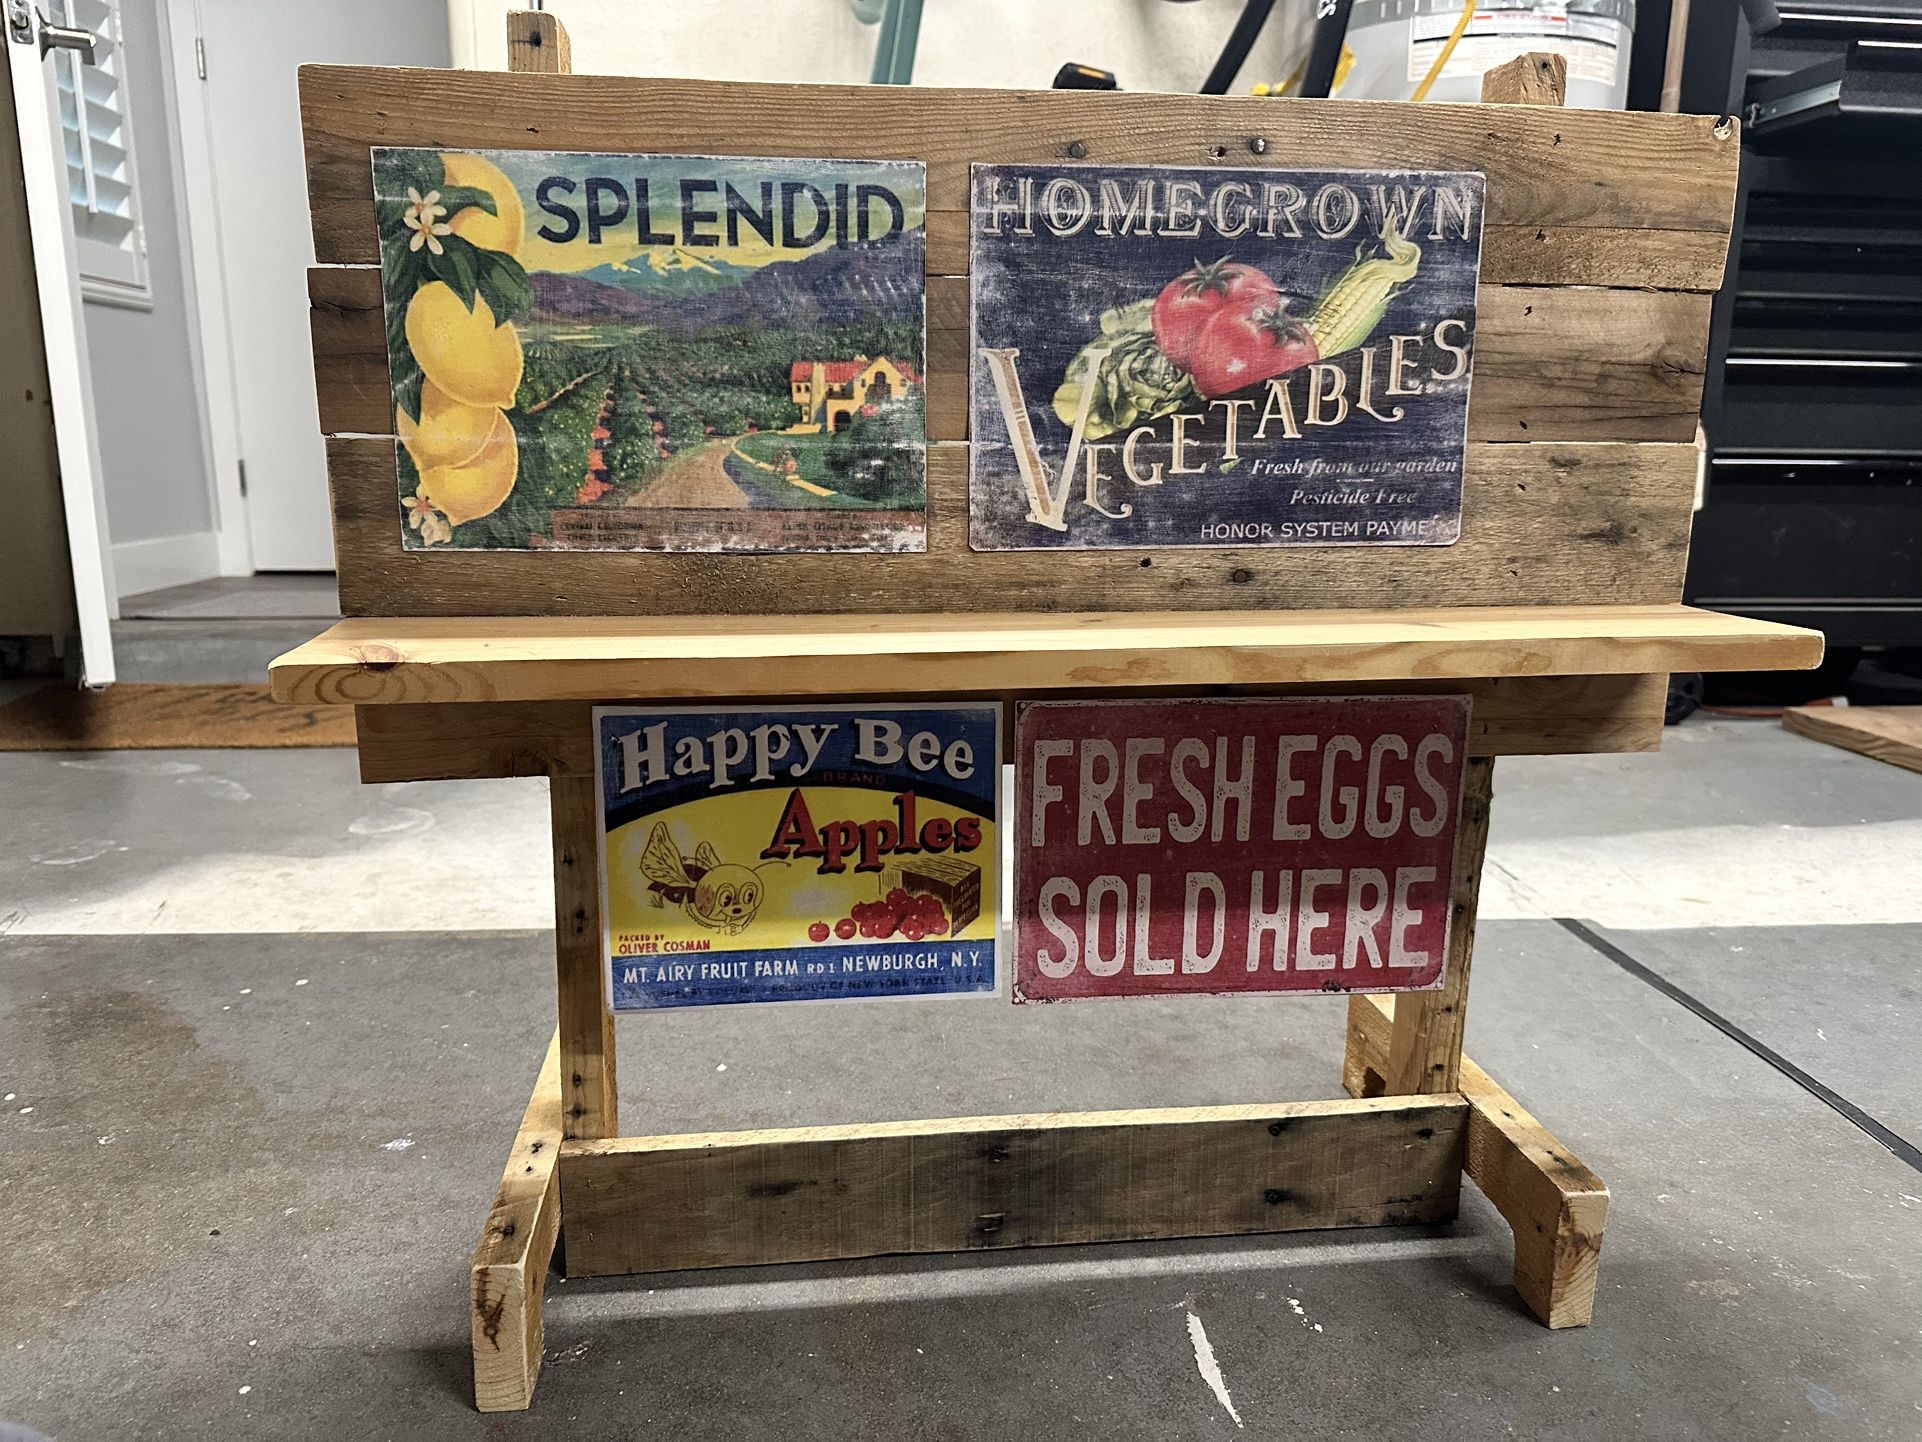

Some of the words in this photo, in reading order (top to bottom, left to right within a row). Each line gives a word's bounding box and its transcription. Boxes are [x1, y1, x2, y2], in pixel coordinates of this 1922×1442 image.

[535, 175, 905, 249] SPLENDID
[983, 176, 1473, 242] HOMEGROWN
[977, 318, 1472, 532] VEGETABLES
[1251, 458, 1303, 475] Fresh
[1305, 458, 1352, 478] from
[1358, 462, 1391, 474] our
[1290, 489, 1370, 505] Pesticide
[1200, 523, 1274, 539] HONOR
[1280, 521, 1359, 538] SYSTEM
[614, 721, 839, 794] Happy
[853, 717, 975, 780] Bee
[822, 771, 886, 786] BRAND
[1031, 735, 1257, 847] FRESH
[1271, 733, 1454, 841] EGGS
[759, 788, 982, 875] Apples
[619, 934, 654, 942] PACKED
[1036, 871, 1226, 979] SOLD
[1245, 866, 1437, 972] HERE
[619, 943, 658, 955] OLIVER
[663, 940, 711, 952] COSMAN
[623, 967, 650, 984] MT.
[656, 965, 695, 982] AIRY
[701, 962, 748, 980] FRUIT
[754, 960, 799, 977] FARM
[807, 962, 825, 974] RD
[829, 962, 835, 973] 1
[842, 953, 944, 973] NEWBURGH,
